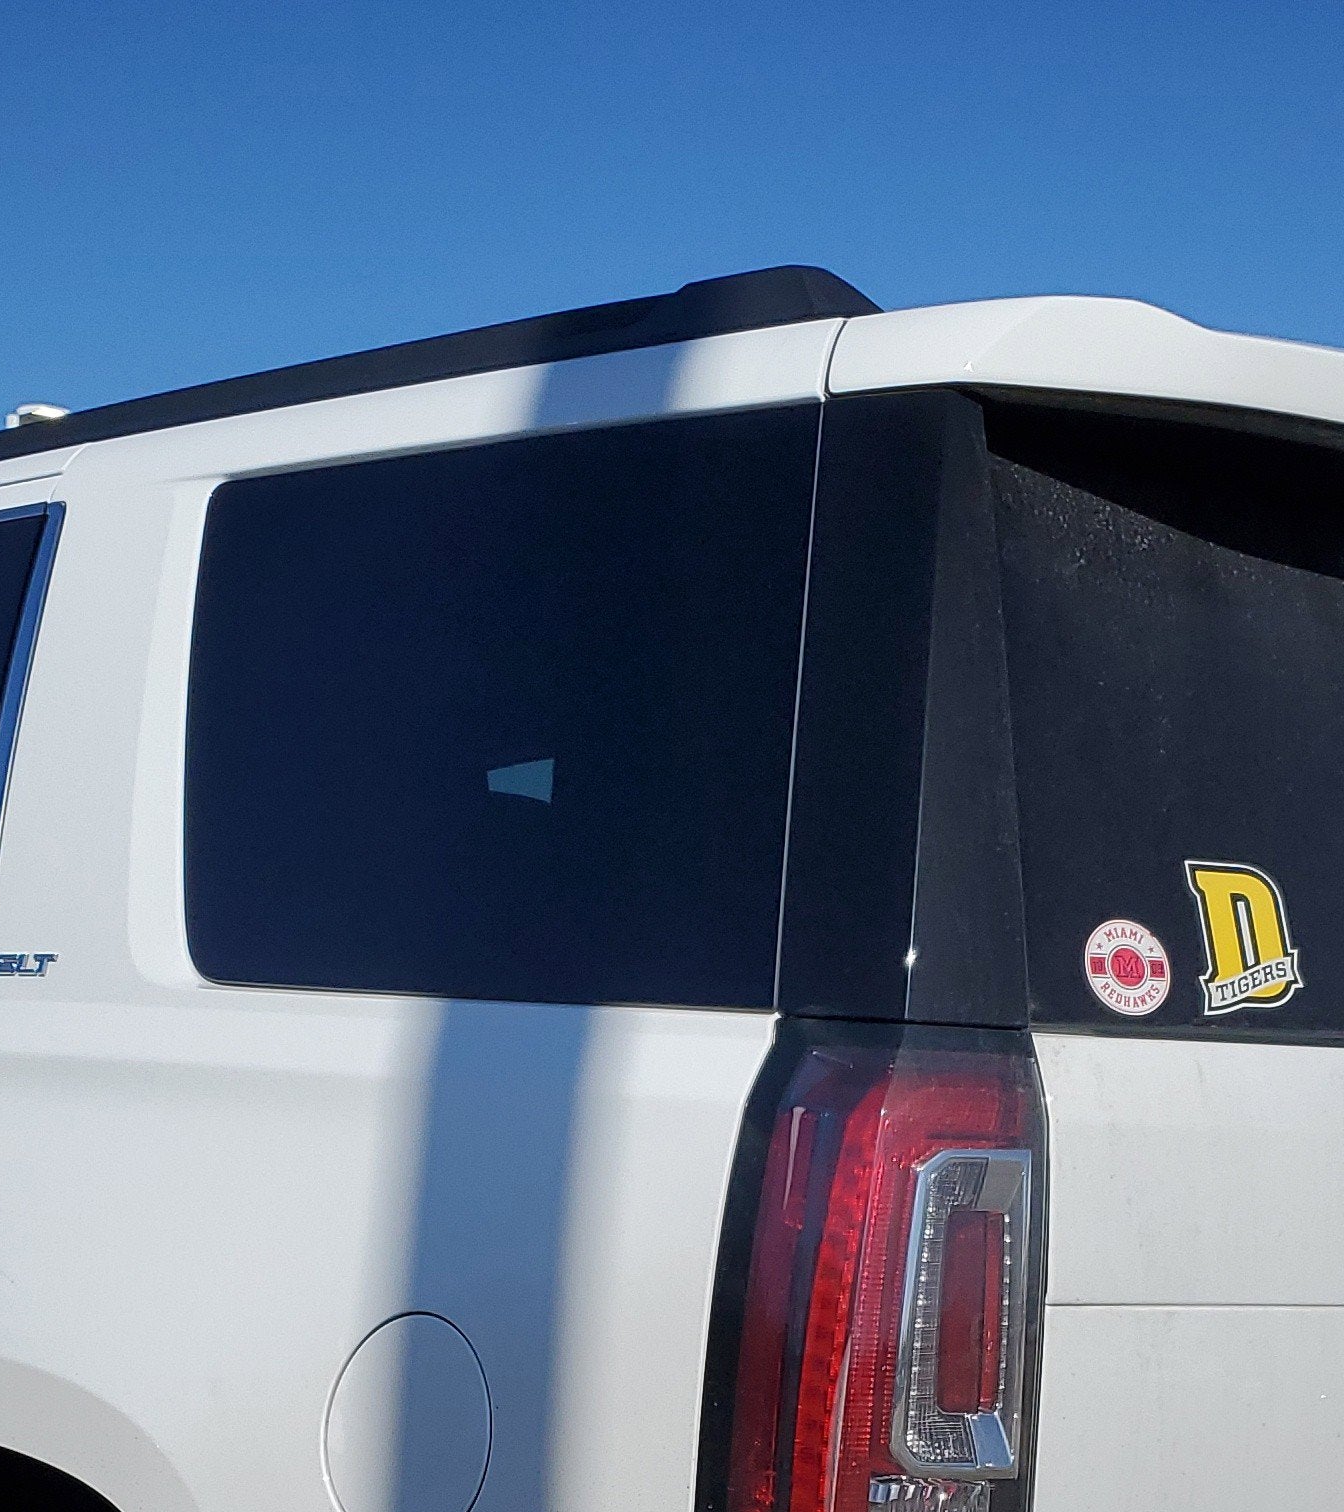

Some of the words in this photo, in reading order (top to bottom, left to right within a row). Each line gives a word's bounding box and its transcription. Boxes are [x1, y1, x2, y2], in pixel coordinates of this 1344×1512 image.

[1103, 926, 1144, 944] MIAMI
[1113, 955, 1141, 979] M
[1215, 960, 1289, 1001] TIGERS
[1100, 981, 1160, 1008] REDHAWKS
